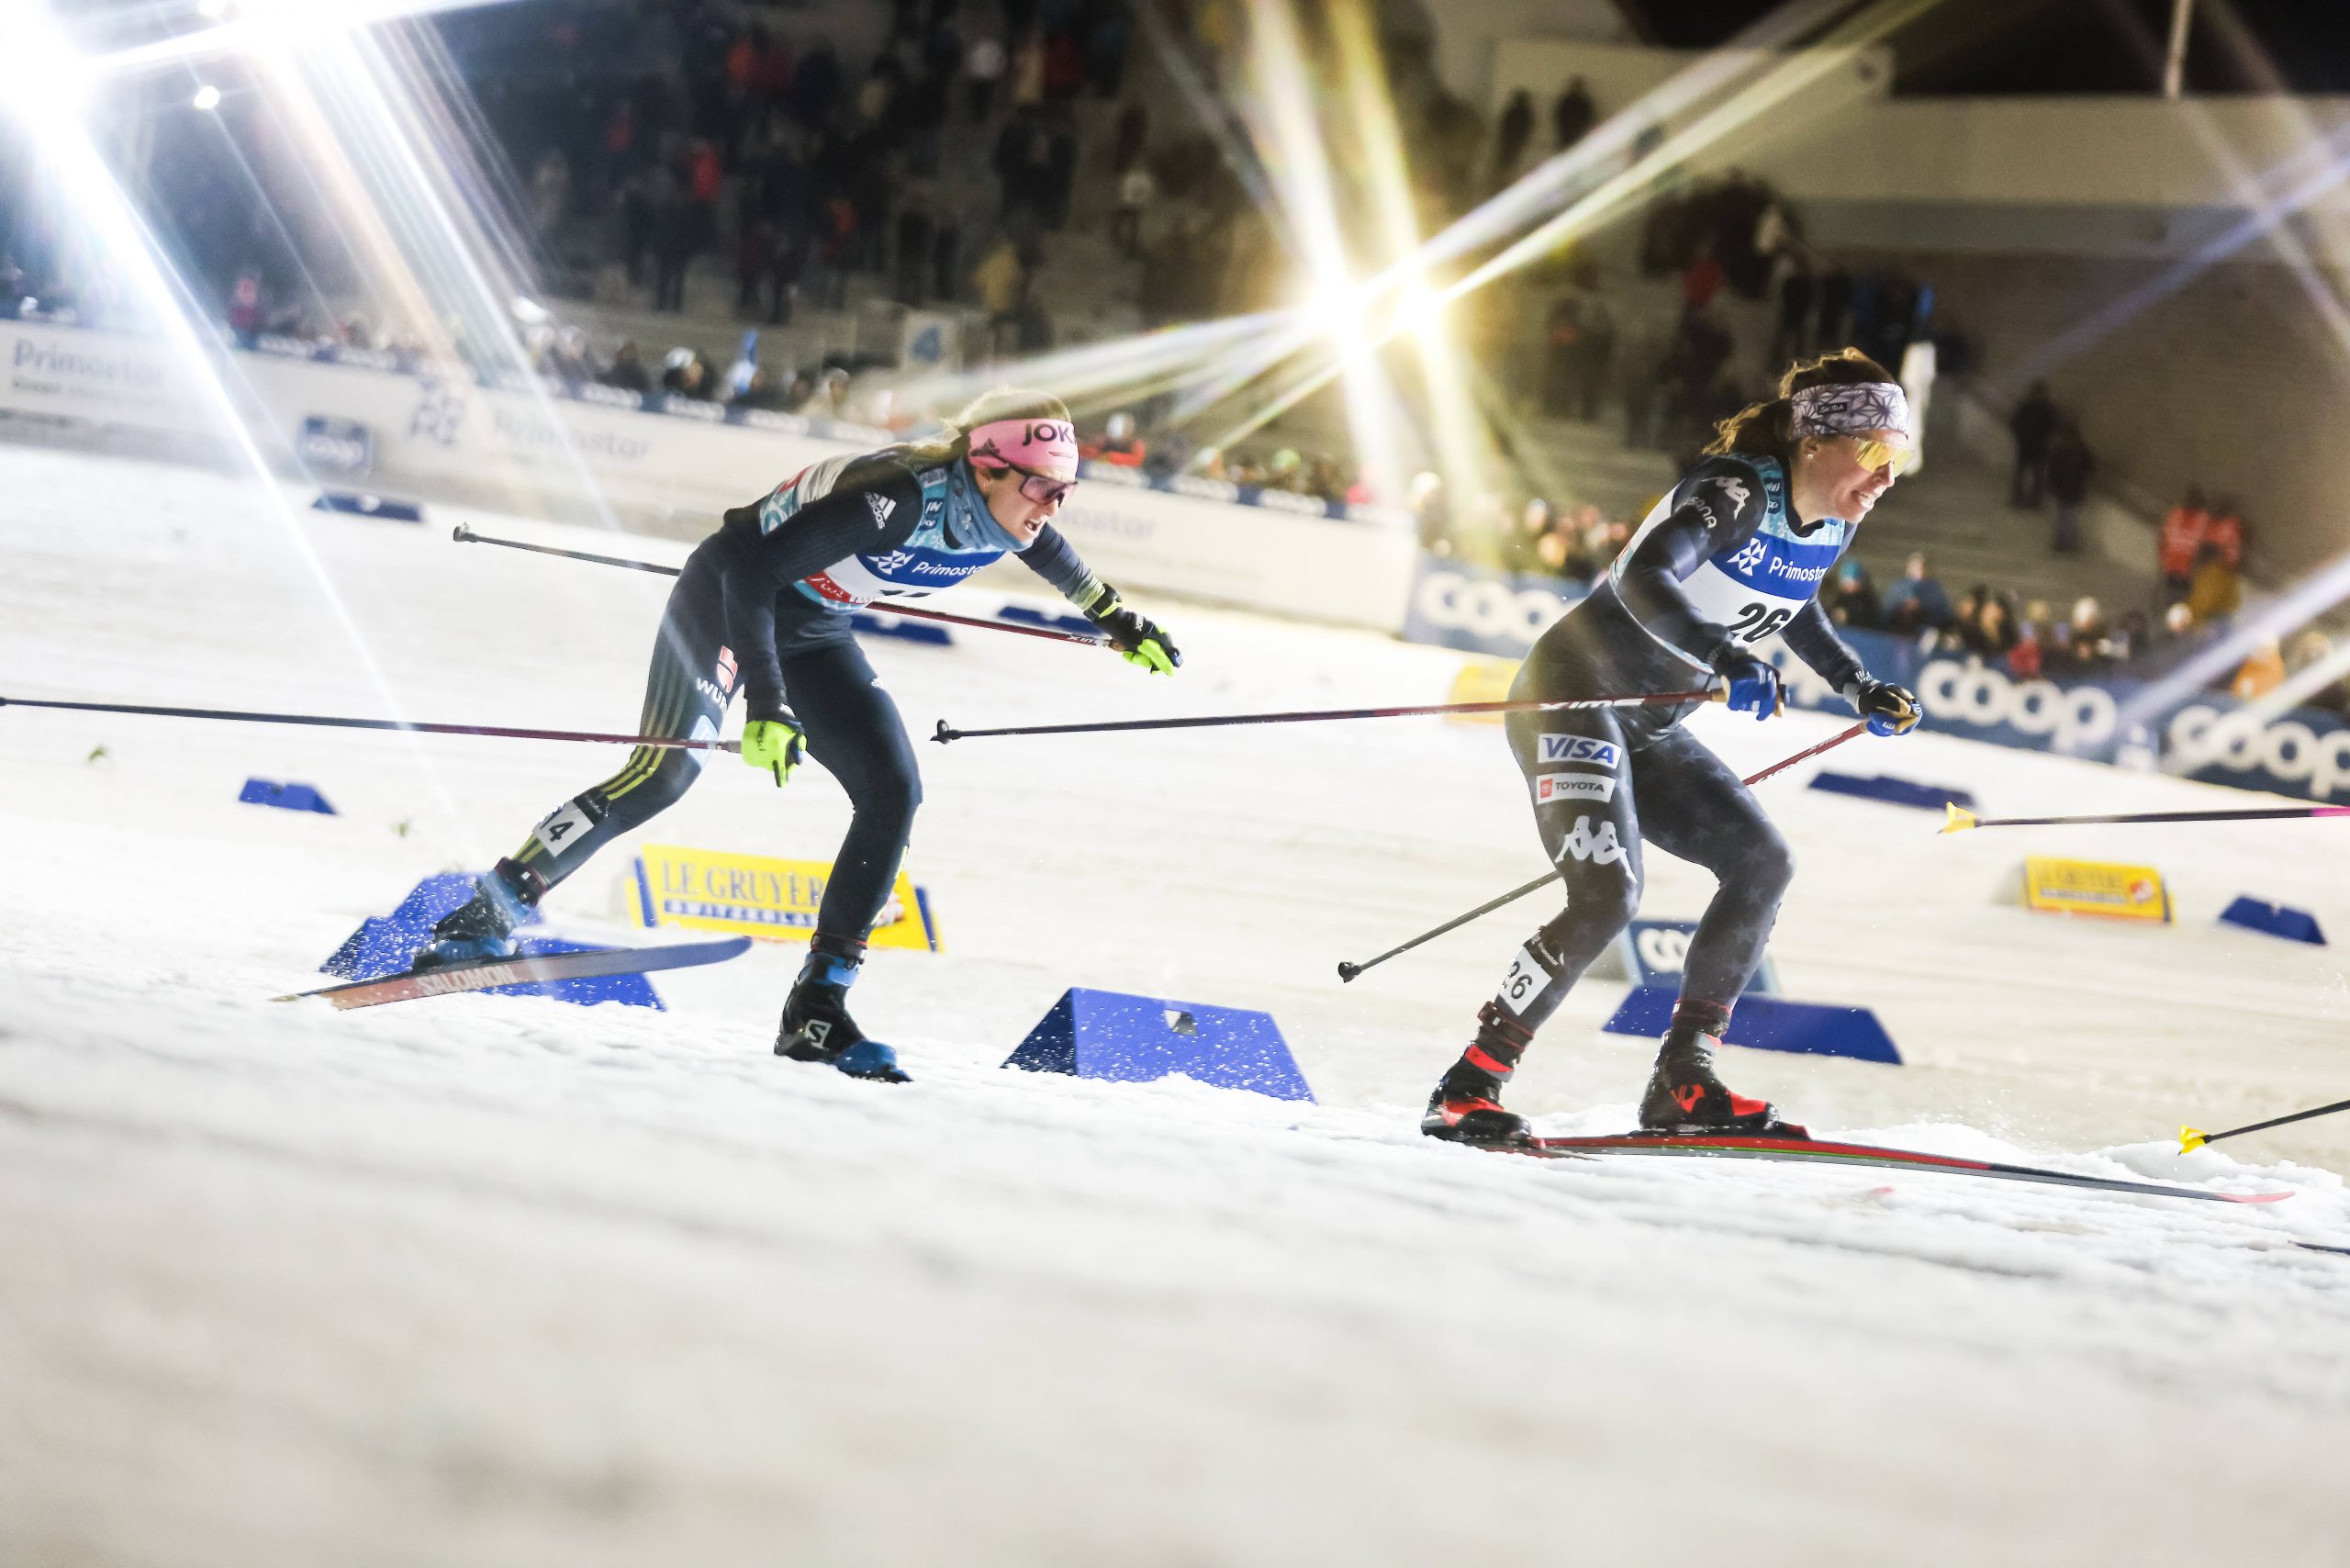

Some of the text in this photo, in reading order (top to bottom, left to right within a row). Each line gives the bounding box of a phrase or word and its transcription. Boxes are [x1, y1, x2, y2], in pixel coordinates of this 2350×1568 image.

[1022, 423, 1078, 446] JOK
[911, 561, 988, 577] Primosta
[1768, 555, 1830, 582] Primosta
[1419, 570, 1590, 643] coo
[1727, 602, 1792, 644] 26
[1917, 657, 2119, 753] coop
[1543, 737, 1615, 765] VISA
[1556, 781, 1605, 793] TOYOTA
[661, 859, 696, 894] LE
